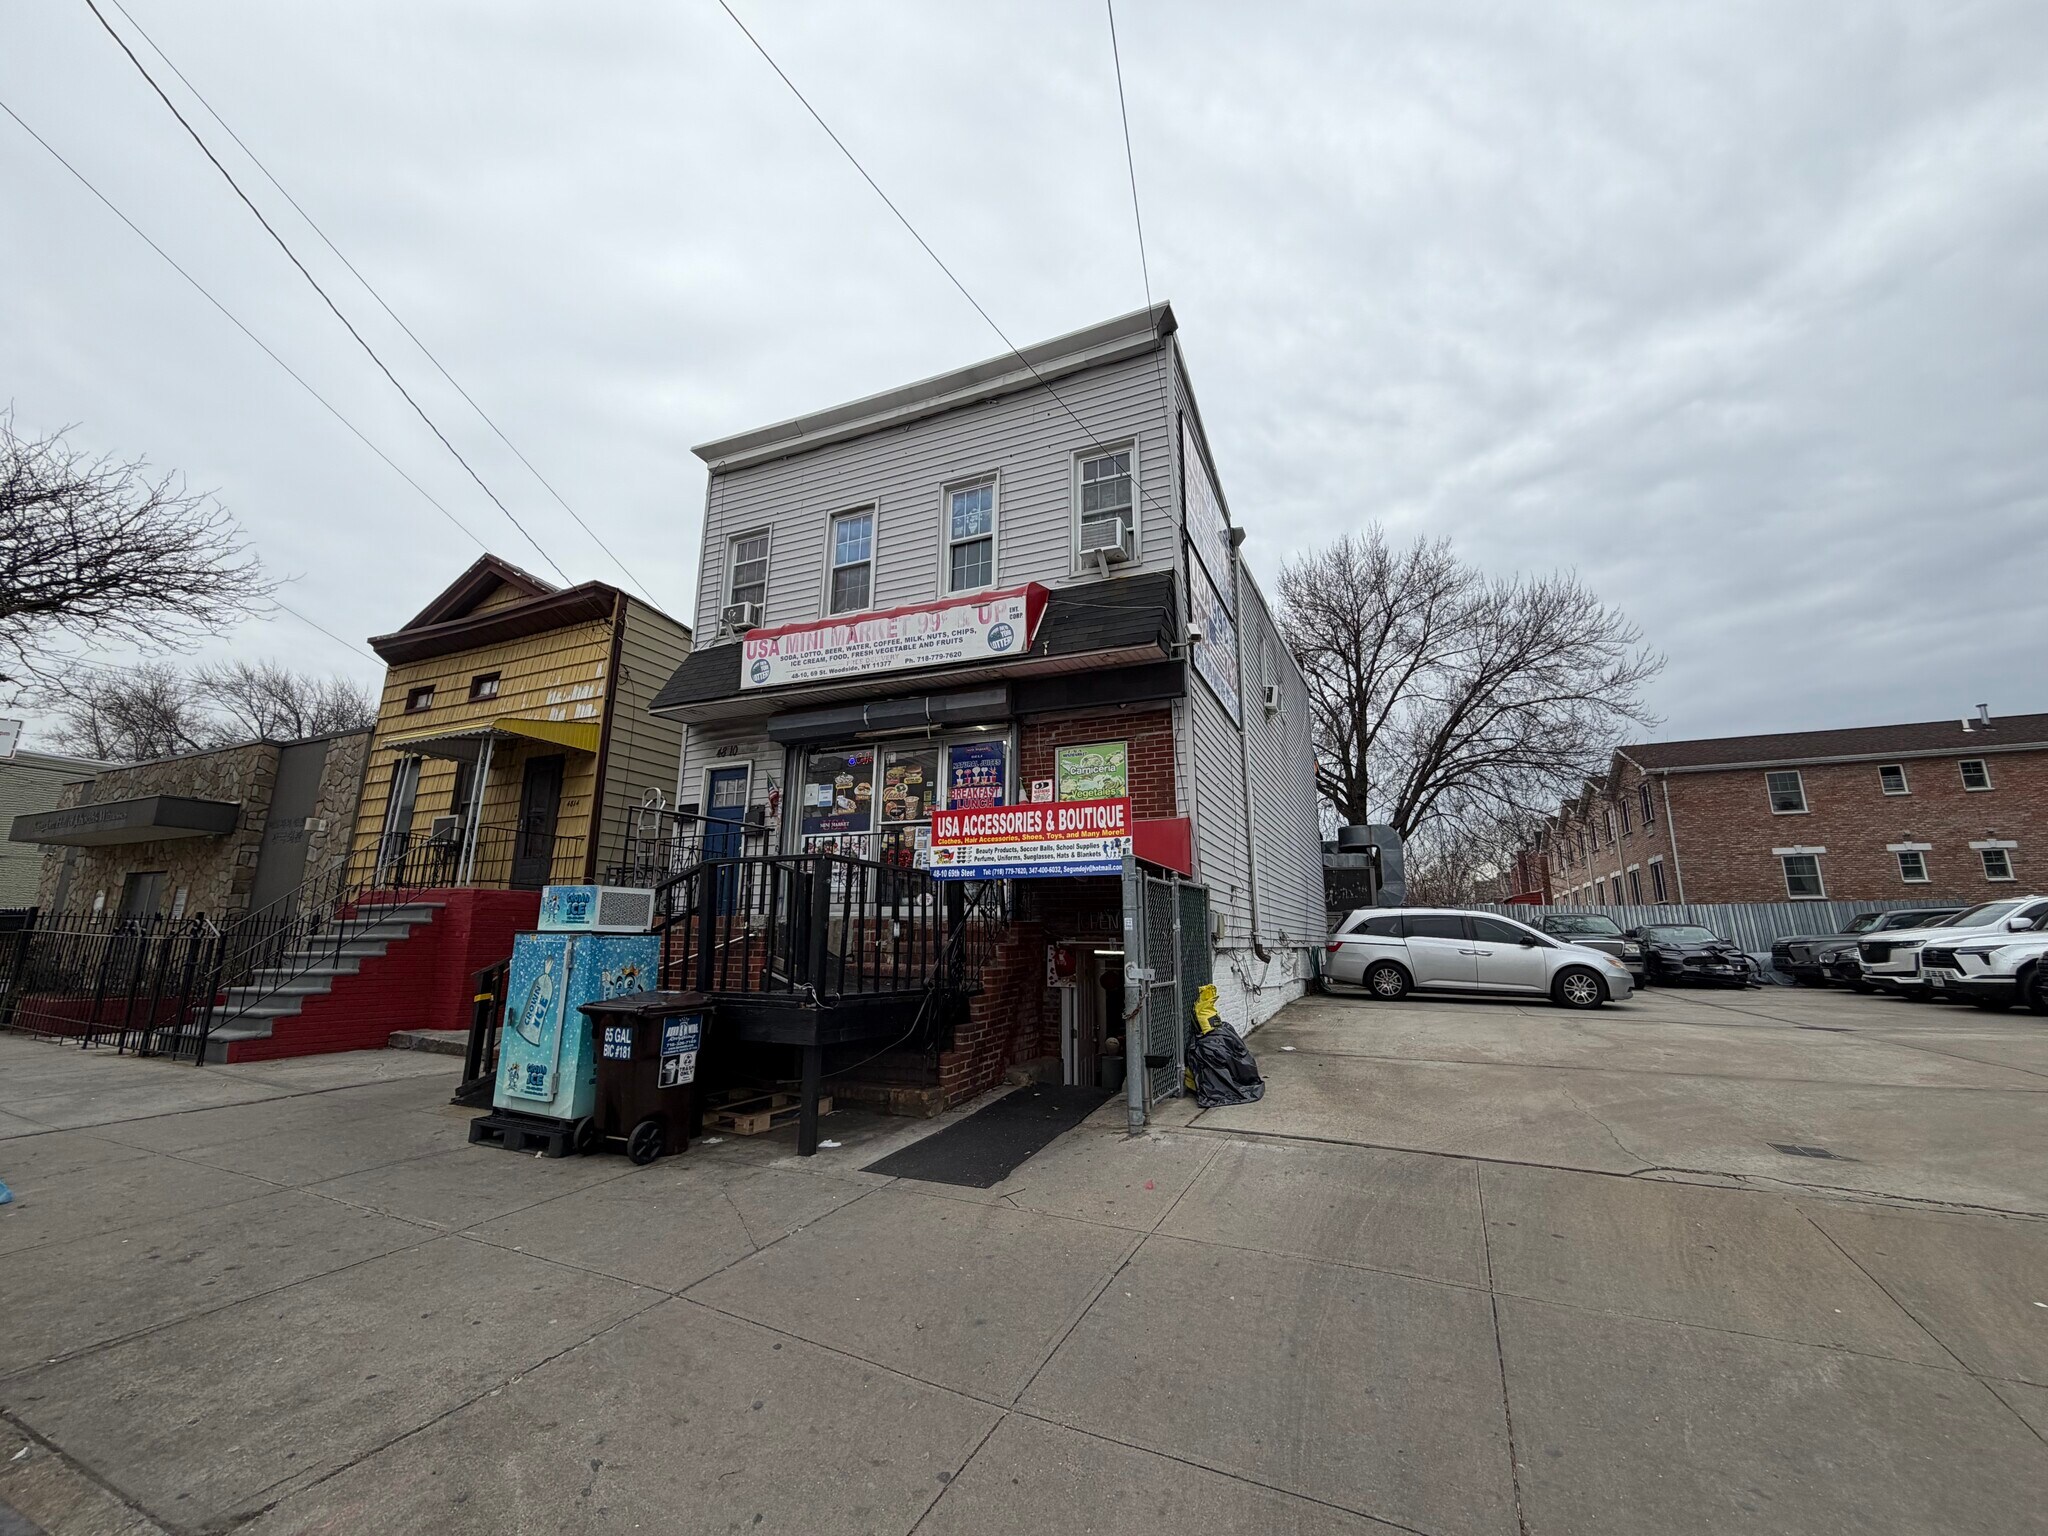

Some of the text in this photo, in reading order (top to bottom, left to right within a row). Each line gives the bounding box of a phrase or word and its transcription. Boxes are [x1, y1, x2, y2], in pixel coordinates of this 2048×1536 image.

[746, 639, 780, 660] USA
[786, 630, 824, 654] MINI
[831, 616, 908, 647] MARKET
[978, 602, 1007, 624] UP
[780, 627, 977, 662] SODA, LOTTO, BEER, WATER, COFFEE, MILK, NUTS, CHIPS,
[803, 655, 828, 666] CREAM,
[829, 652, 849, 662] FOOD,
[851, 650, 874, 659] FRESH
[875, 644, 917, 655] VEGETABLE
[919, 641, 934, 649] AND
[936, 636, 964, 646] FRUITS
[791, 672, 810, 680] 48-10,
[829, 665, 860, 674] Woodside,
[872, 660, 892, 668] 11377
[917, 651, 962, 663] 718-779-7620
[950, 786, 1000, 800] BREAKFAST
[1071, 788, 1116, 799] Vegetales
[957, 798, 995, 809] LUNCH
[937, 804, 1125, 838] USA ACCESSORIES & BOUTIQUE
[979, 834, 1021, 843] Accessories,
[1022, 833, 1045, 841] Shoes,
[1046, 832, 1065, 840] Toys,
[1081, 830, 1100, 838] Many
[1101, 828, 1125, 836] More!!
[975, 846, 993, 855] Beauty
[994, 844, 1019, 853] Products,
[1040, 844, 1055, 852] Balls,
[1056, 843, 1075, 851] School
[1076, 842, 1100, 851] Supplies
[973, 855, 996, 863] Perfume,
[997, 853, 1022, 862] Uniforms,
[1023, 852, 1055, 861] Sunglasses,
[1056, 851, 1070, 859] Hats
[1076, 850, 1102, 858] Blankets
[932, 869, 947, 878] 48-10
[948, 869, 960, 877] 69th
[960, 868, 976, 877] Steet
[991, 867, 1004, 876] (718)
[1005, 867, 1028, 875] 779-7620,
[566, 901, 586, 916] ICE
[524, 985, 541, 1026] CROWN
[533, 995, 548, 1028] ICE
[604, 1027, 632, 1044] 65 GAL
[603, 1044, 631, 1059] BIC #181
[526, 1072, 544, 1087] ICE
[680, 1069, 693, 1077] ONLY
